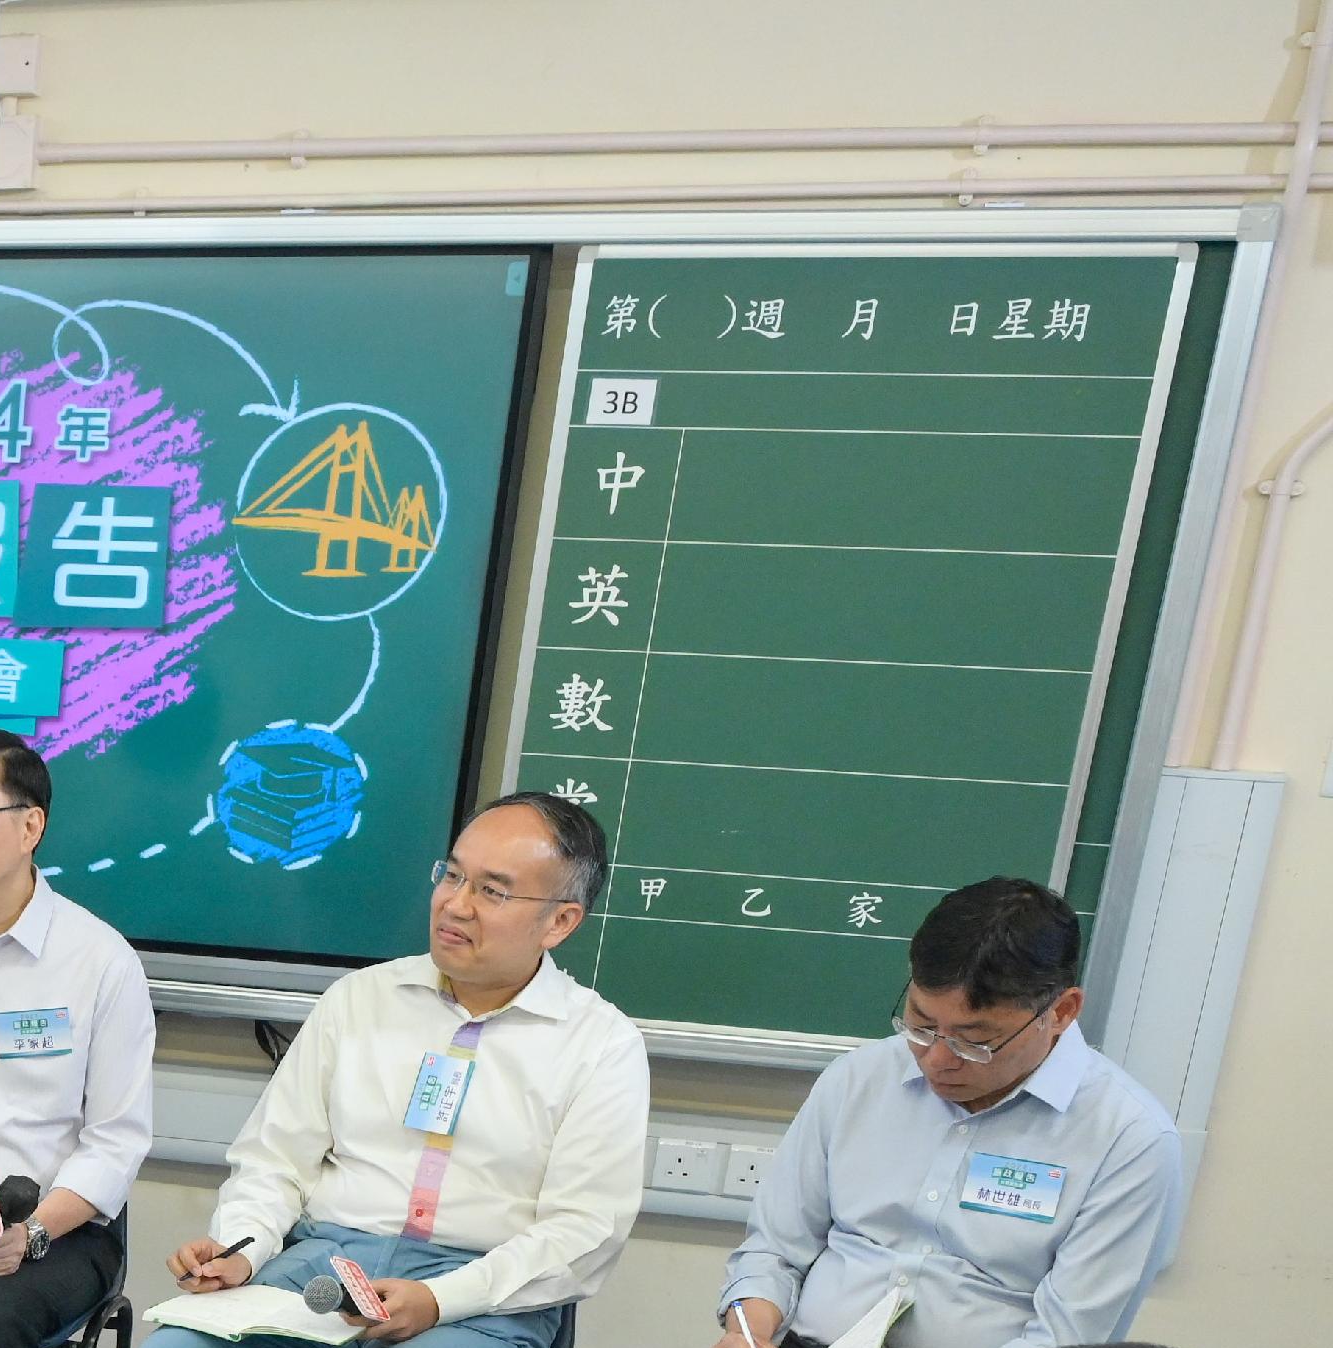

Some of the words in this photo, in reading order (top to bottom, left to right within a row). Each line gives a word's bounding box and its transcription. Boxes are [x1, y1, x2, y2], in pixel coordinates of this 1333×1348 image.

[841, 298, 880, 341] 月
[603, 391, 638, 414] 3B
[596, 451, 646, 515] 中
[568, 564, 629, 627] 英
[549, 673, 614, 732] 數
[639, 878, 668, 912] 甲
[741, 887, 772, 917] 乙
[847, 884, 884, 928] 家
[976, 1187, 1021, 1207] 林世雄
